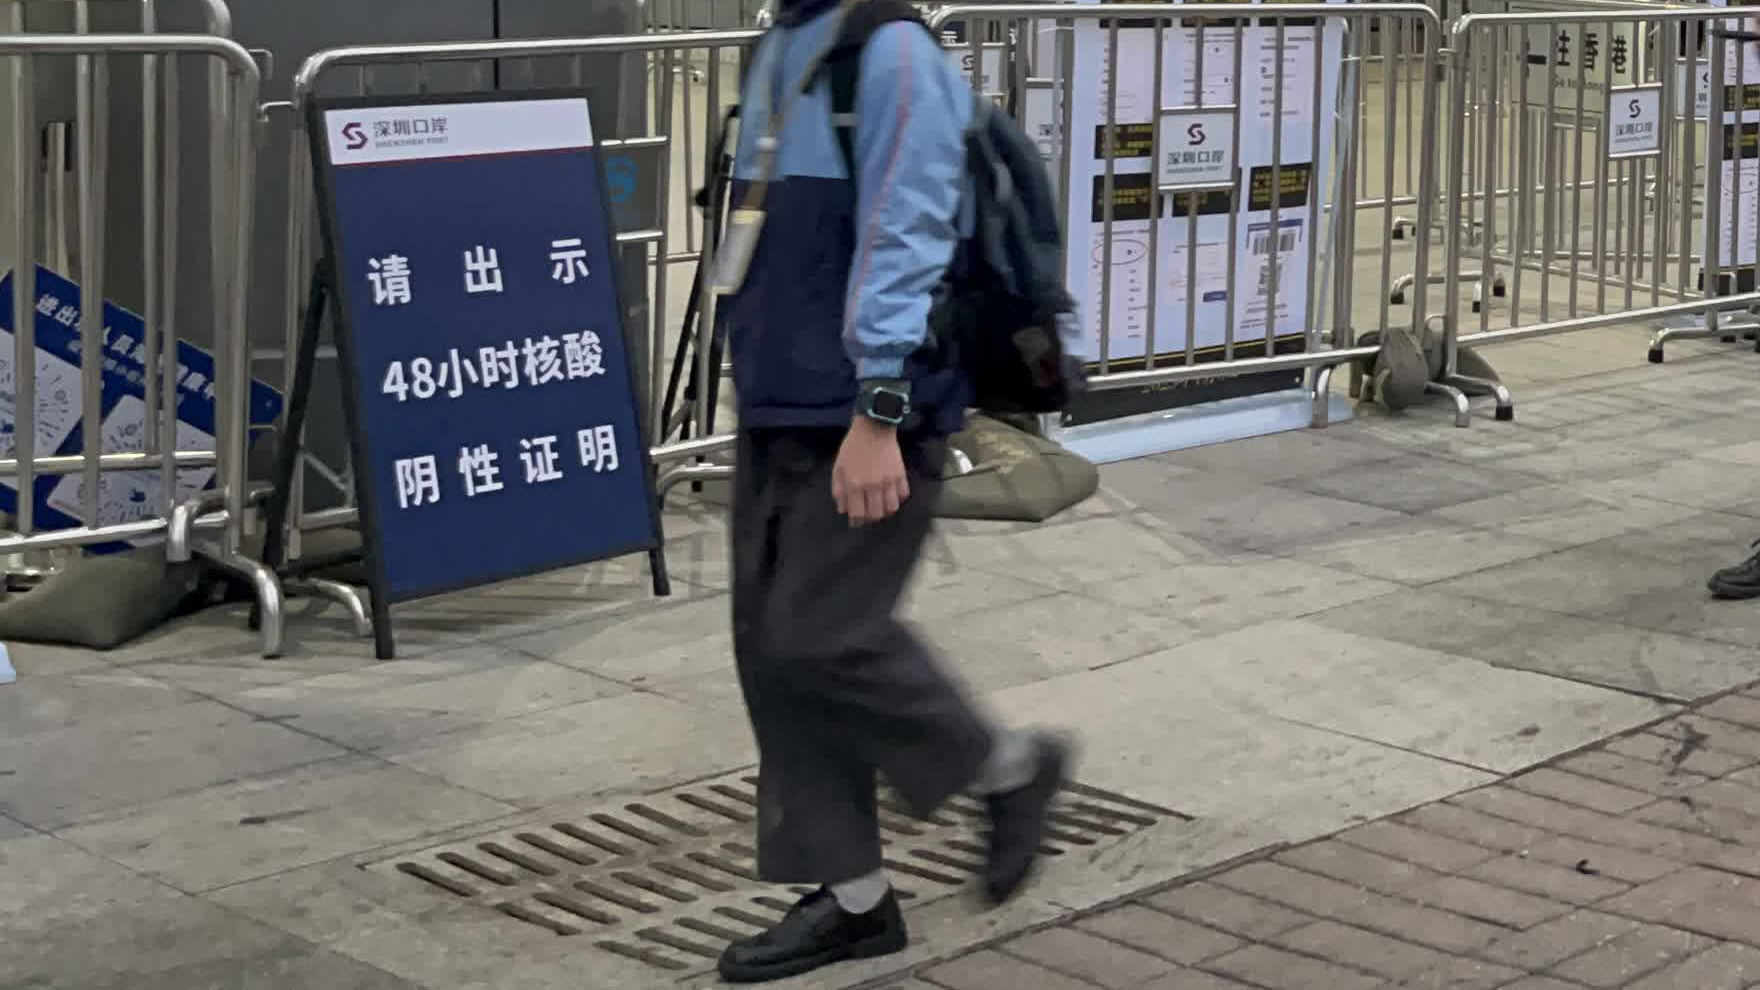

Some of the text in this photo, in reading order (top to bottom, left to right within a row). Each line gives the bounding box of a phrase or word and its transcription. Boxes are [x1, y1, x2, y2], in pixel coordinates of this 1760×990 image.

[373, 117, 449, 139] 深圳口岸
[366, 237, 591, 306] 请出示
[382, 329, 606, 402] 48小时核酸
[394, 423, 621, 509] 阴性证明
